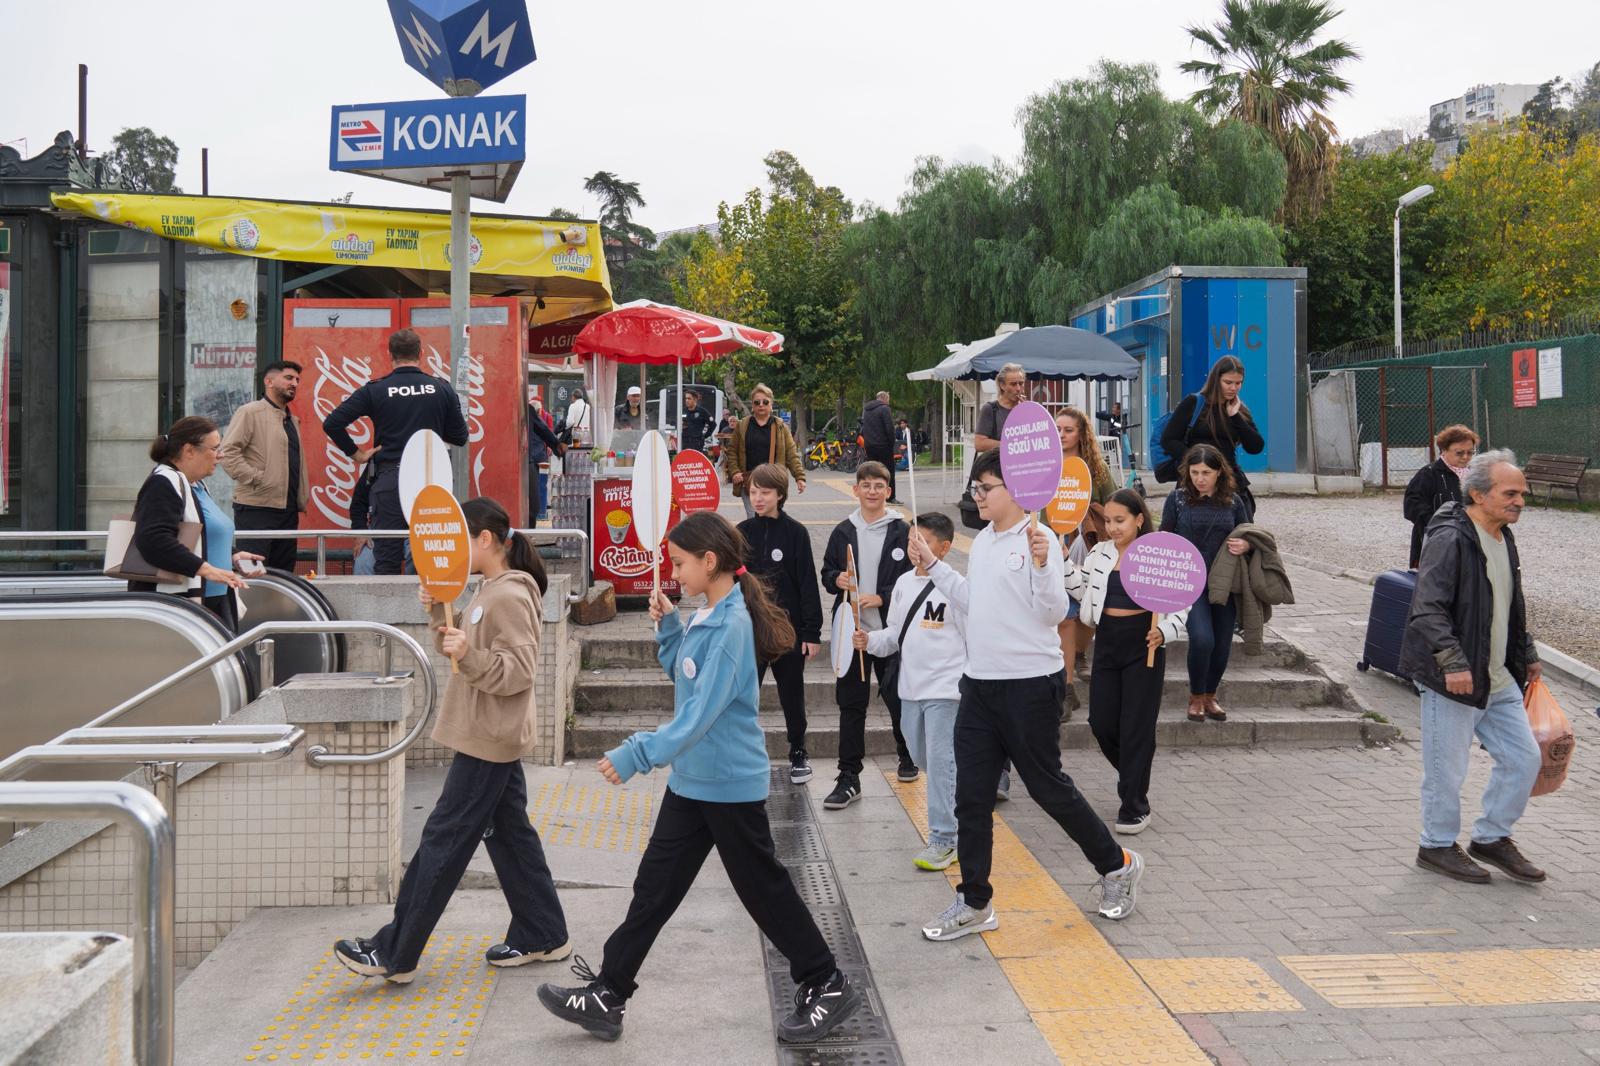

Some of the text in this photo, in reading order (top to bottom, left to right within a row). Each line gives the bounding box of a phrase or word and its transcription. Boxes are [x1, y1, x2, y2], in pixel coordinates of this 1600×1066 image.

[459, 9, 518, 68] M
[341, 120, 362, 128] METRO
[393, 110, 519, 152] KONAK
[161, 215, 195, 226] EV YAPIMI
[162, 225, 195, 237] TADINDA
[386, 228, 420, 239] EV YAPIMI
[386, 238, 418, 250] TADINDA
[193, 346, 256, 368] Hürriye
[1004, 420, 1050, 440] ÇOCUKLARIN
[1007, 436, 1050, 456] SÖZÜ VAR
[414, 522, 462, 537] ÇOCUKLARIN
[423, 539, 456, 552] HAKLARI
[1136, 544, 1193, 560] ÇOCUKLAR
[433, 556, 449, 569] VAR
[1128, 552, 1201, 574] YARININ DEĞİL,
[1138, 565, 1188, 581] BUGÜNÜN
[1129, 572, 1195, 592] BİREYLERİDİR
[923, 600, 947, 622] M
